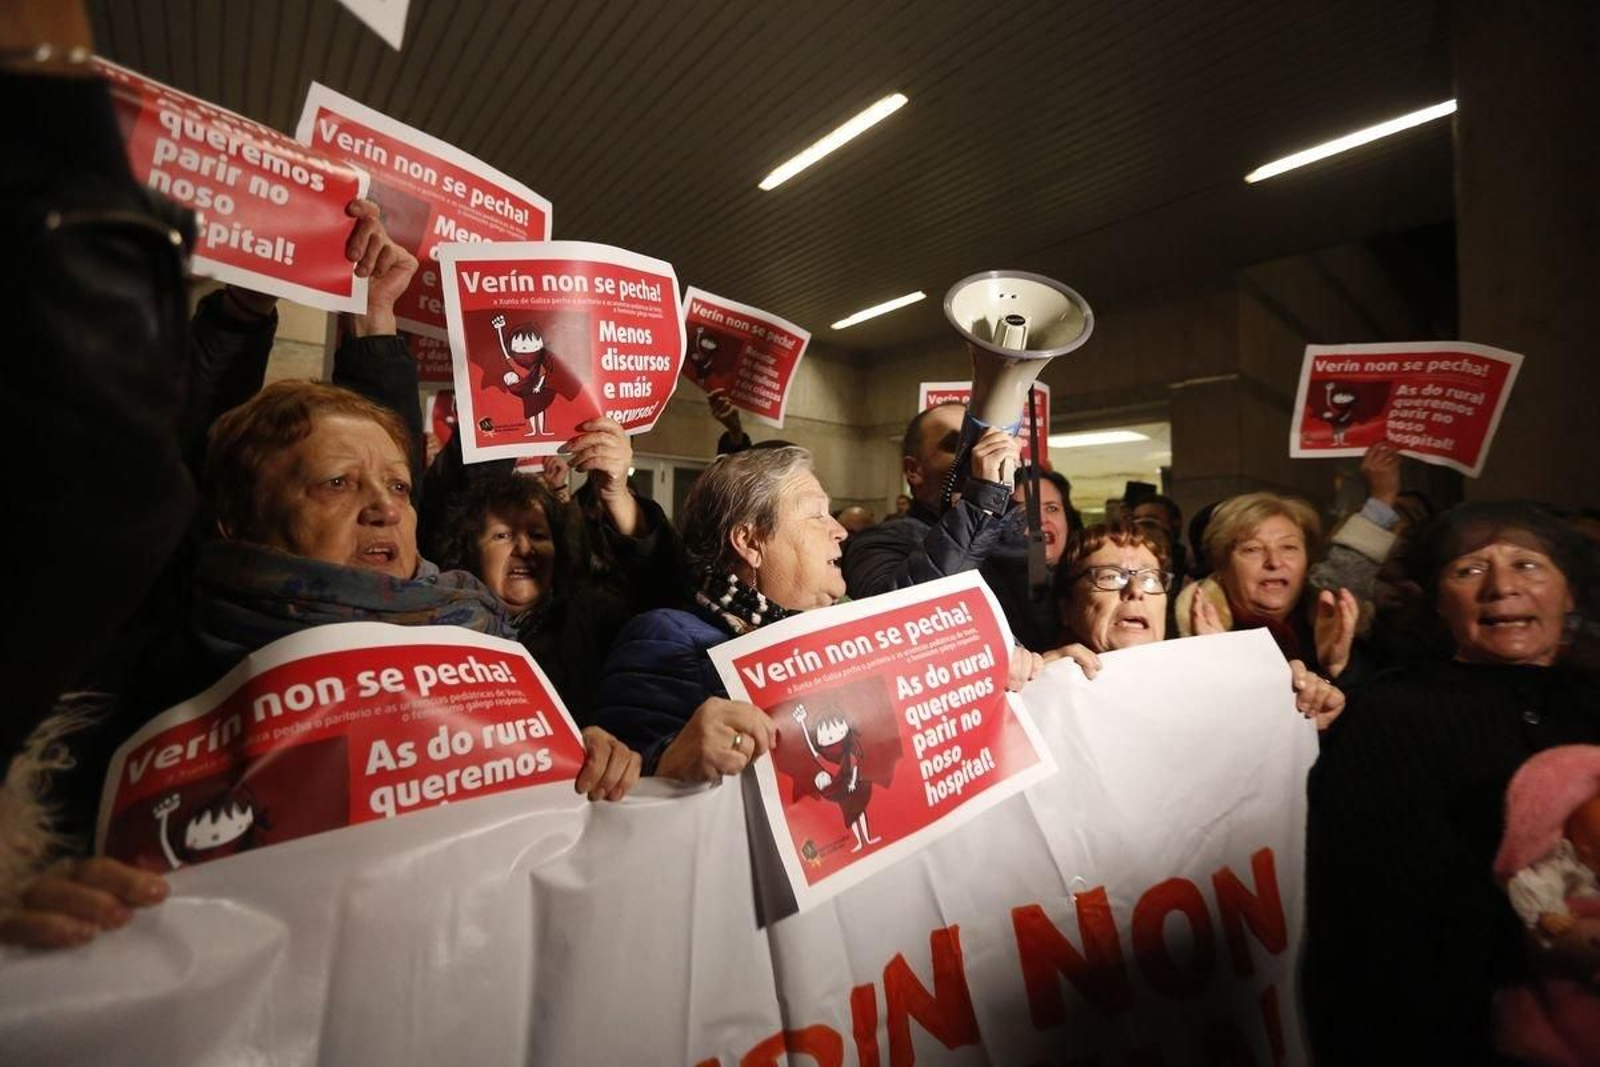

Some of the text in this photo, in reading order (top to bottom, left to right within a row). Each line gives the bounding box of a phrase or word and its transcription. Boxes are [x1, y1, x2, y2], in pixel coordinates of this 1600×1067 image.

[158, 109, 325, 193] queremos
[152, 137, 289, 206] parir no
[319, 119, 388, 166] Verín
[394, 154, 438, 186] non
[442, 175, 467, 198] se
[470, 187, 529, 227] pecha!
[149, 169, 235, 216] noso
[197, 213, 296, 266] pital!
[422, 270, 437, 287] e
[461, 270, 662, 303] Verín non se pecha!
[599, 320, 653, 345] Menos
[692, 301, 725, 323] Verín
[726, 315, 749, 331] non
[751, 323, 766, 337] se
[601, 347, 671, 372] discursos
[1315, 358, 1490, 377] Verín non se pecha!
[603, 375, 653, 399] e máis
[1396, 383, 1486, 405] As do rural
[1387, 407, 1454, 424] parir no
[1392, 398, 1475, 416] queremos
[1386, 420, 1425, 432] noso
[1386, 429, 1456, 450] hospital!
[742, 648, 823, 689] Verín
[825, 635, 874, 665] non
[874, 626, 905, 649] se
[904, 601, 974, 646] pecha!
[896, 675, 924, 701] As
[924, 663, 951, 689] do
[951, 644, 996, 679] rural
[128, 713, 242, 785] Verín
[252, 676, 346, 723] non
[357, 665, 405, 699] se
[414, 655, 518, 697] pecha!
[325, 706, 372, 731] paritorio
[374, 706, 383, 715] e
[384, 704, 398, 714] as
[402, 713, 410, 721] o
[905, 676, 995, 730] queremos
[365, 710, 554, 776] As do rural
[911, 708, 983, 760] parir no
[919, 745, 963, 781] noso
[924, 746, 997, 808] hospital!
[369, 746, 553, 819] queremos
[1012, 847, 1289, 1032] NON
